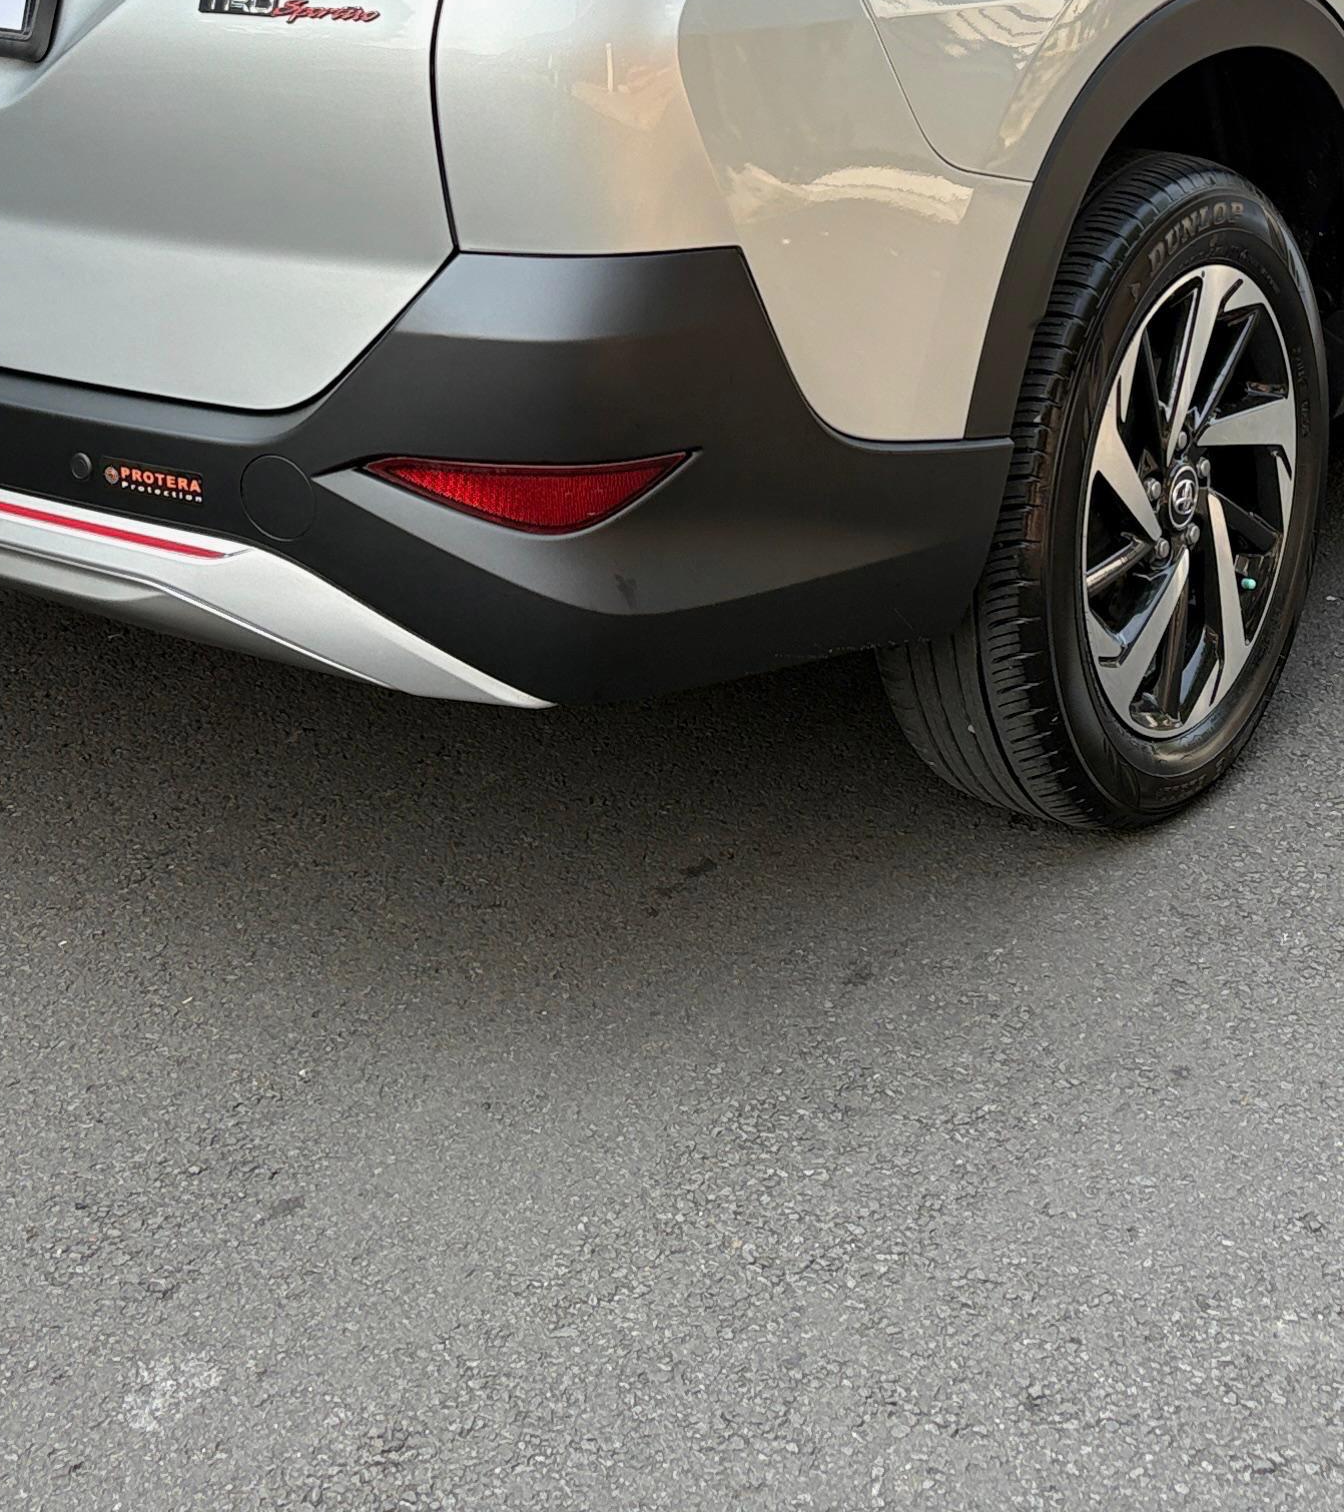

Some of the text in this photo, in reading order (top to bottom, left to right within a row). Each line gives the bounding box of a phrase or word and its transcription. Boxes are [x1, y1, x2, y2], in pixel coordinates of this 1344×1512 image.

[1148, 201, 1244, 277] DUNLOP
[120, 466, 201, 493] PROTERA
[121, 481, 203, 503] Protection
